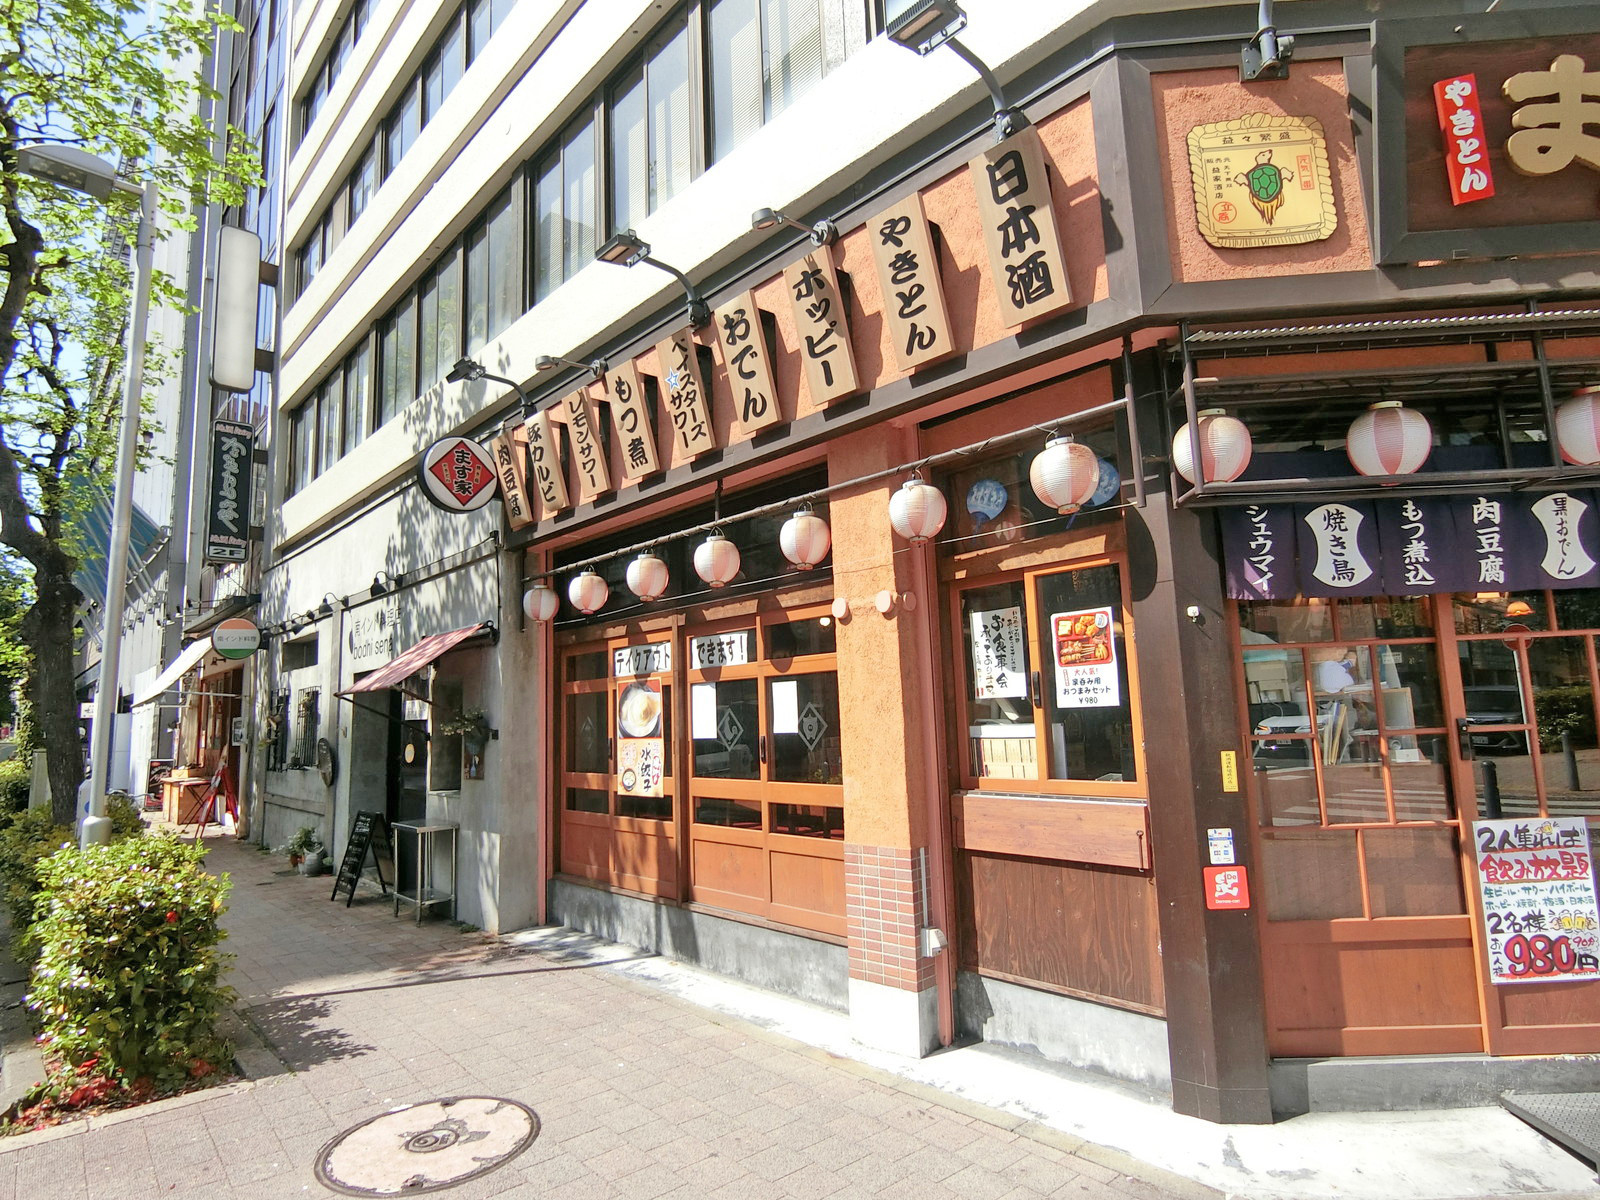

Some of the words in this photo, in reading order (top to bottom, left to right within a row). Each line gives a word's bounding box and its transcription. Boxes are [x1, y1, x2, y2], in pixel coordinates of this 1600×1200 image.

[1222, 132, 1291, 144] 益々繁盛
[1444, 80, 1487, 193] やきとん
[986, 150, 1055, 309] 日本酒
[880, 216, 936, 356] やきとん
[723, 308, 767, 423] おでん
[792, 268, 838, 387] ホッピー
[614, 376, 648, 470] もつ煮
[670, 391, 690, 449] サワー
[671, 338, 707, 443] ベイスターズ
[454, 449, 473, 495] ます家
[527, 423, 556, 503] 豚カルビ
[569, 393, 597, 488] レモンサワー
[497, 444, 521, 518] 肉豆腐
[213, 548, 242, 557] 2F
[1246, 505, 1274, 591] シュウマイ
[1323, 508, 1356, 583] 焼き鳥
[1401, 500, 1436, 586] もつ煮込
[1472, 497, 1505, 584] 肉豆腐
[1551, 498, 1577, 575] 黒おでん
[616, 644, 670, 673] テイクアウト
[1063, 686, 1111, 695] おつまみセット
[1480, 851, 1589, 882] 飲み放題
[1487, 908, 1548, 934] 2名様
